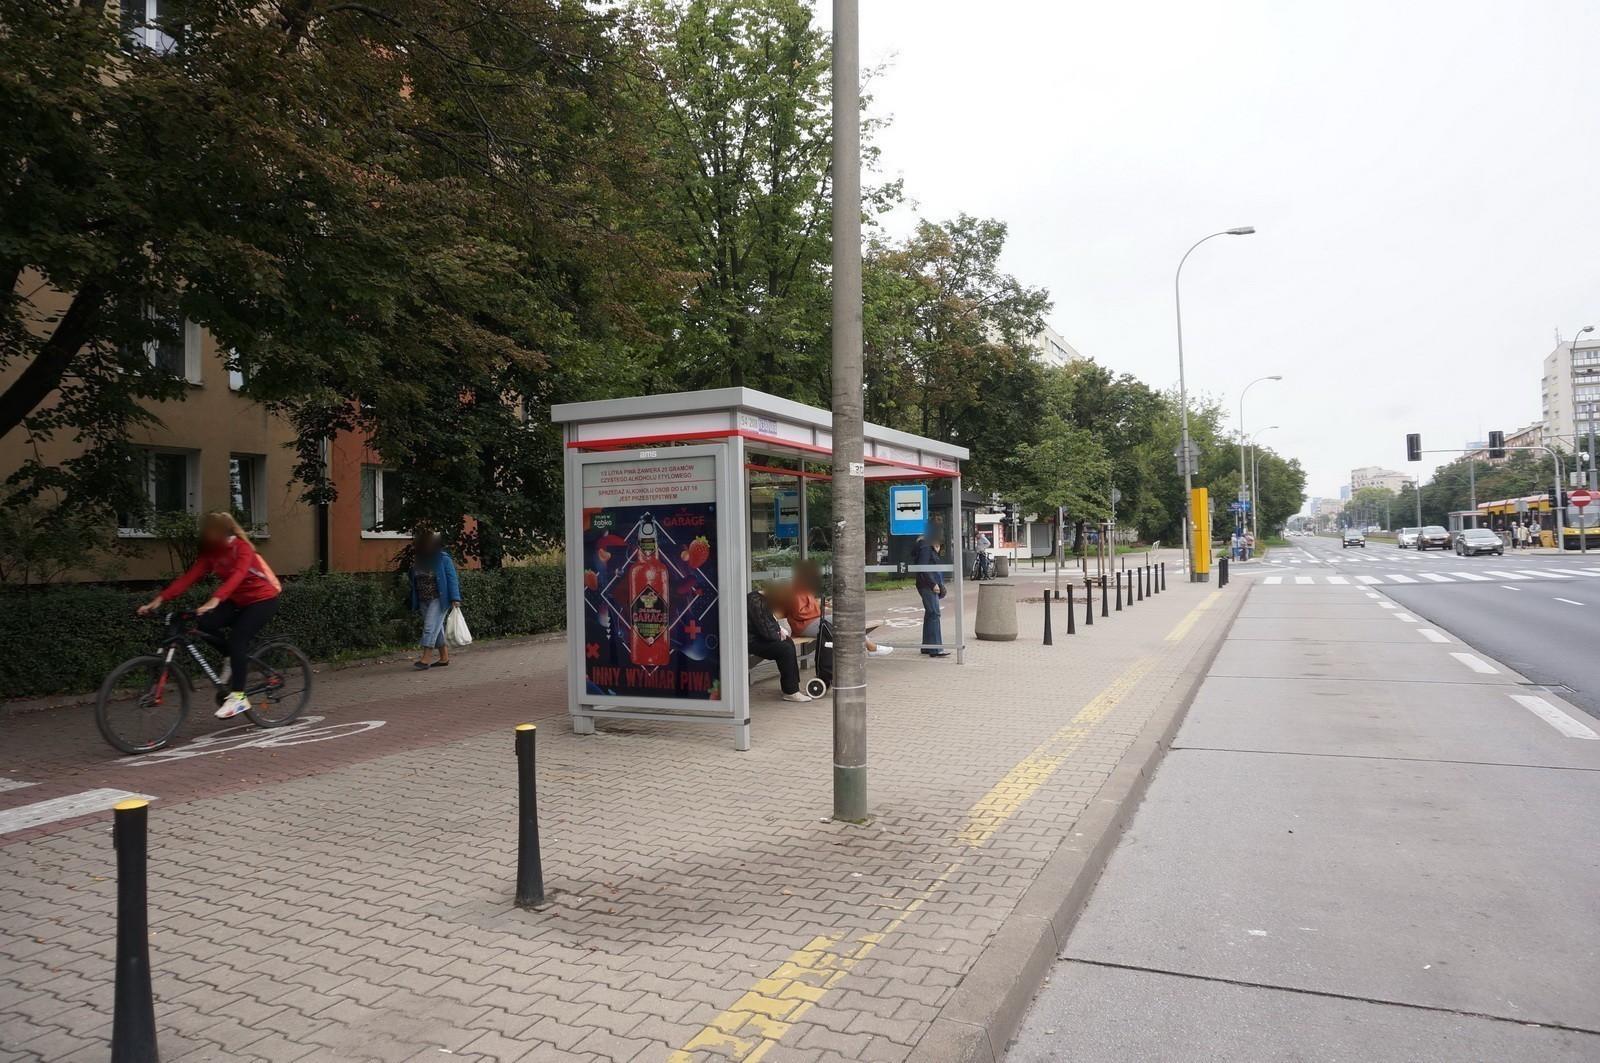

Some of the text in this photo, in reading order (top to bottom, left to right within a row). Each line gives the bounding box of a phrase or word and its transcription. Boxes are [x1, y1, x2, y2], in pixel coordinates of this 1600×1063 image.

[637, 467, 661, 475] ZAWIERA
[669, 464, 694, 472] GRAMÓW
[628, 474, 657, 482] ALKOHOLU
[657, 472, 692, 481] ETYLOWEGO
[598, 488, 625, 496] SPRZEDAŻ
[626, 487, 654, 495] ALKOHOLU
[663, 516, 705, 526] GARAGE
[633, 612, 667, 623] GARAGE
[592, 666, 711, 691] INNY WYMIAR PIWA
